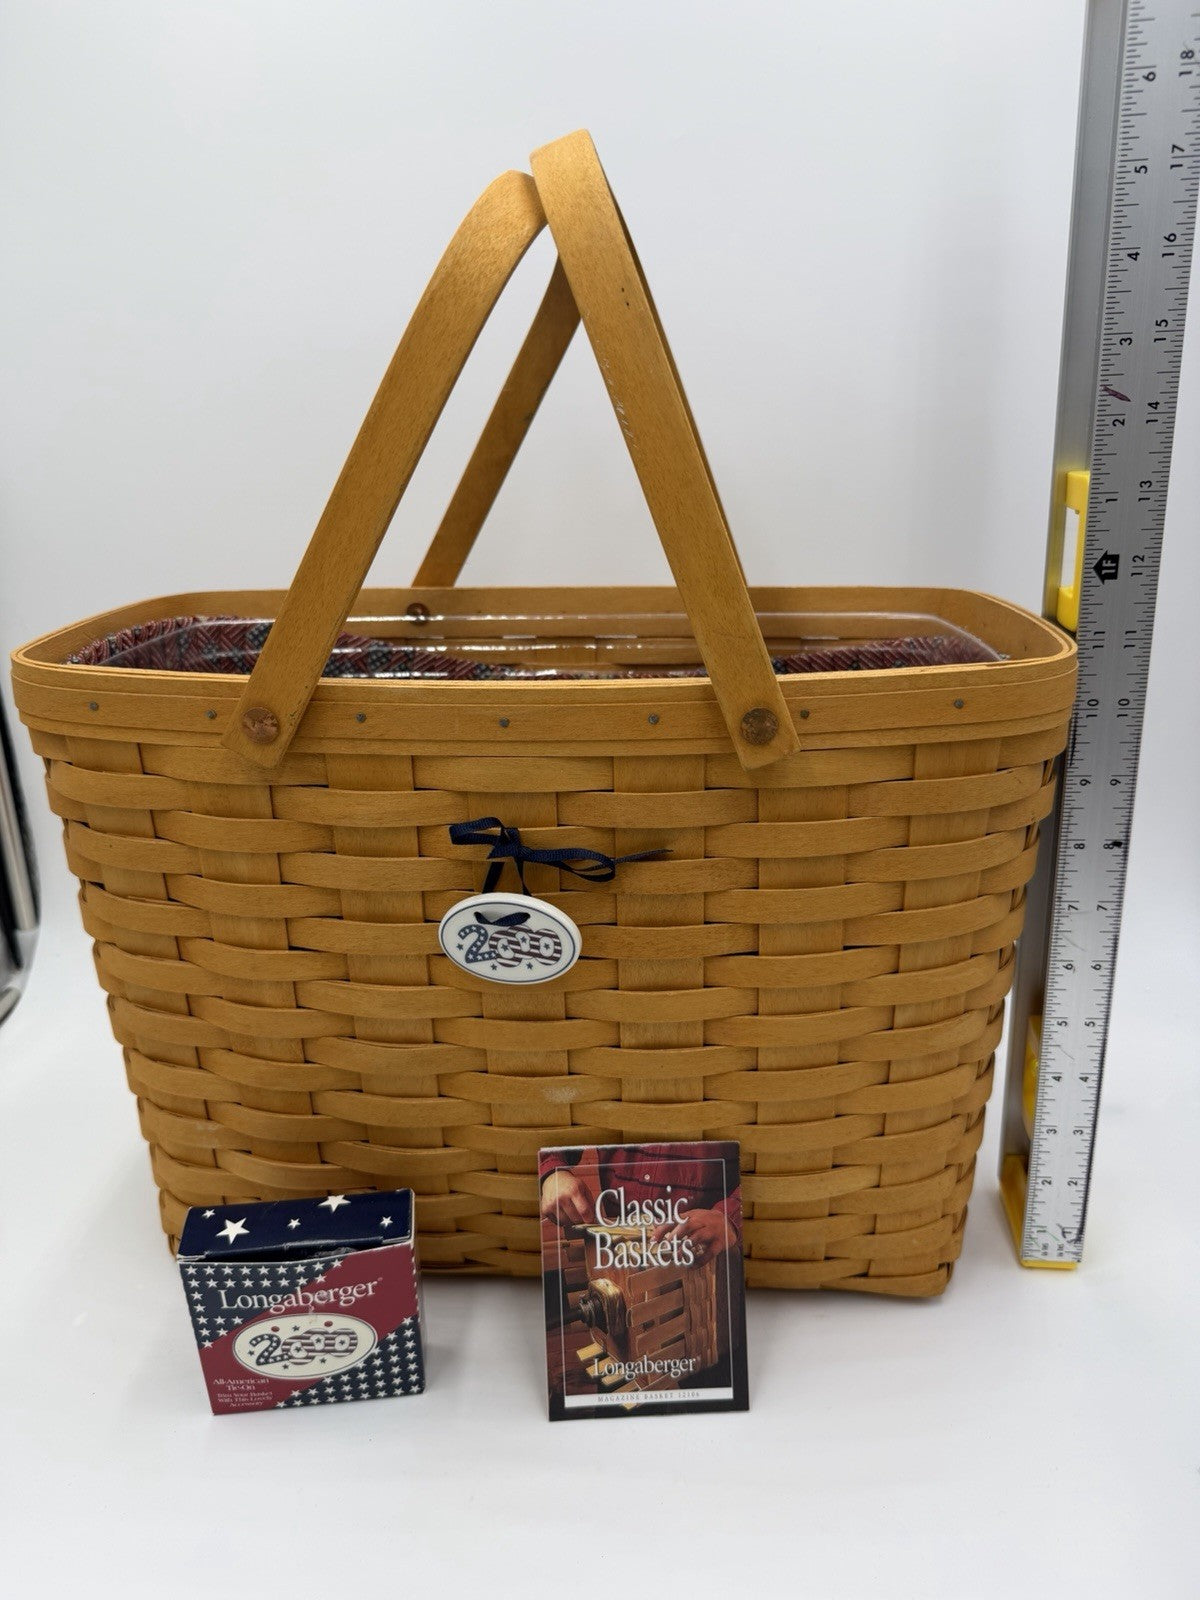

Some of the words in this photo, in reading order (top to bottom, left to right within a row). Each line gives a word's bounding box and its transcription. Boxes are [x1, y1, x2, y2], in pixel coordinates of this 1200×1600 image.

[1178, 50, 1195, 77] 18
[1142, 71, 1156, 82] 6
[1170, 144, 1185, 169] 17
[1134, 165, 1148, 174] 5
[1162, 232, 1177, 258] 16
[1127, 251, 1140, 261] 4
[1153, 319, 1169, 343] 15
[1119, 337, 1133, 346] 3
[1145, 401, 1160, 424] 14
[1112, 418, 1126, 427] 2
[1138, 480, 1153, 502] 13
[1130, 555, 1145, 577] 12
[1092, 631, 1106, 649] 11
[1123, 630, 1137, 649] 11
[1086, 698, 1099, 718] 10
[1116, 698, 1130, 718] 10
[1079, 778, 1092, 787] 9
[1110, 778, 1122, 787] 9
[1073, 842, 1086, 850] 8
[1103, 842, 1115, 850] 8
[1067, 904, 1079, 912] 7
[1096, 904, 1108, 912] 7
[458, 924, 562, 968] 2000
[1062, 962, 1074, 971] 6
[1091, 962, 1102, 971] 6
[594, 1185, 689, 1228] Classic
[593, 1227, 694, 1269] Baskets
[218, 1280, 378, 1314] Longaberger
[249, 1328, 358, 1366] 2000
[592, 1354, 697, 1380] Longaberger
[598, 1393, 640, 1402] MAGAZINE
[644, 1391, 673, 1400] BASKET
